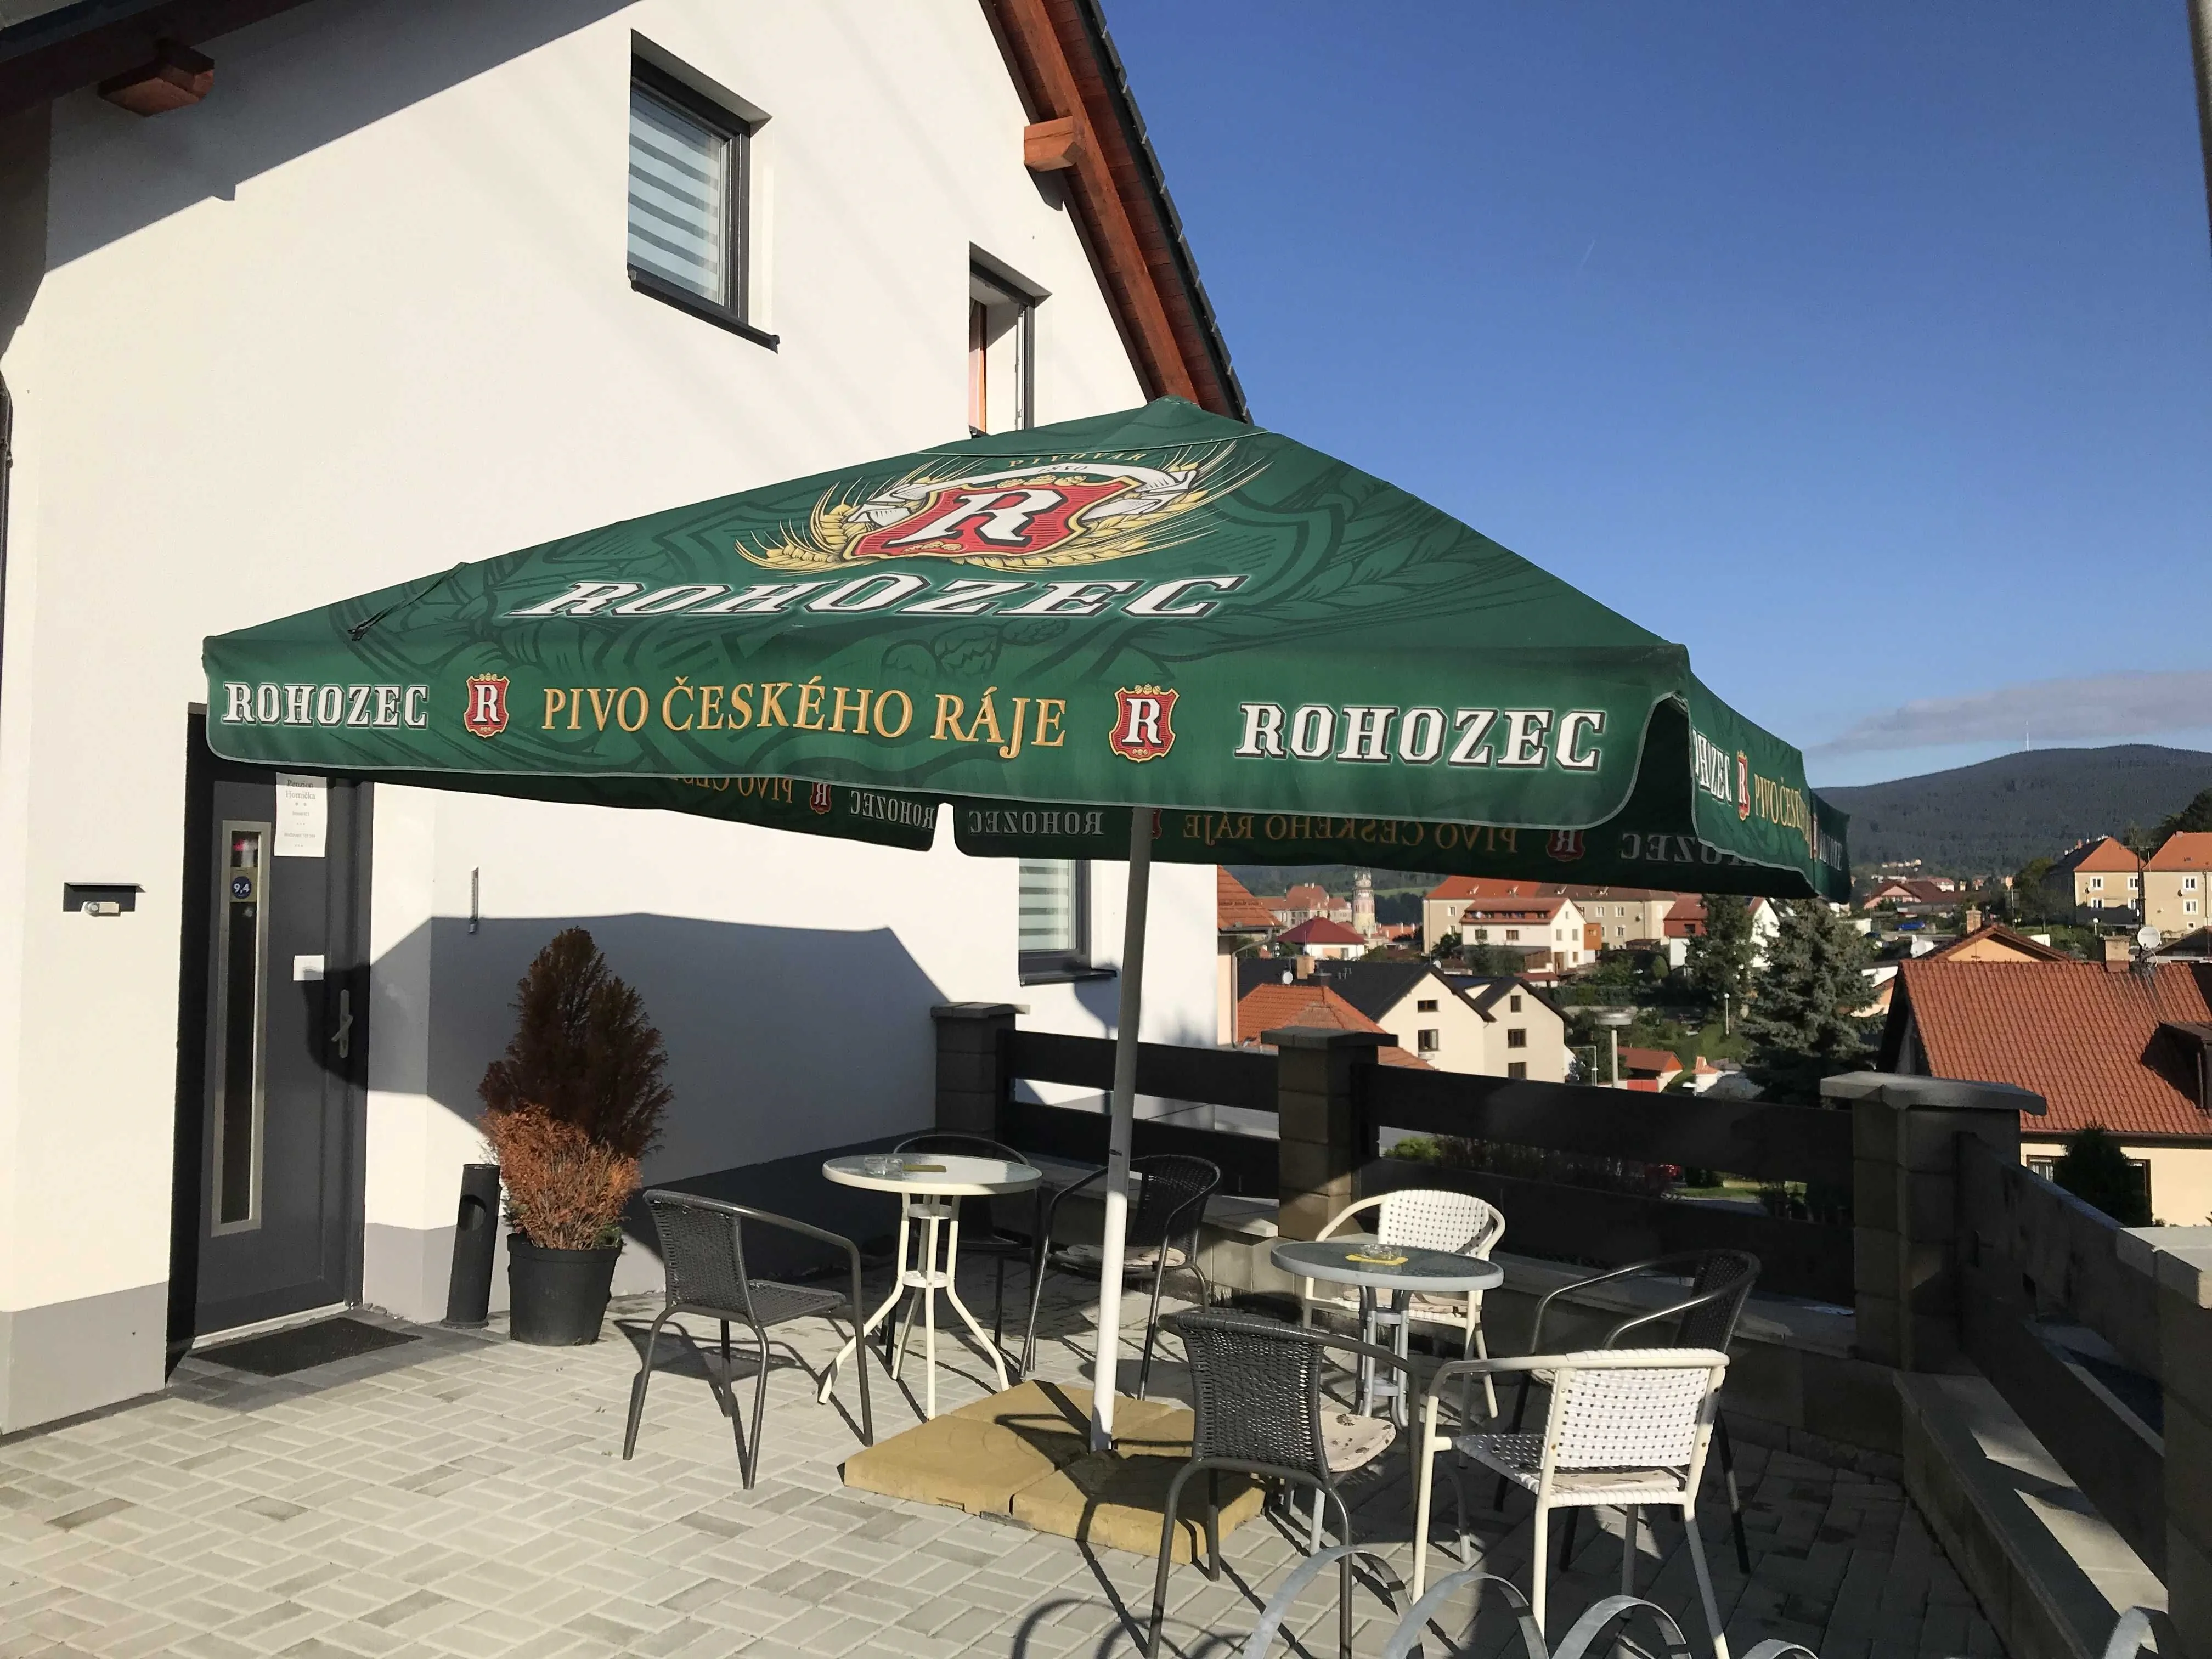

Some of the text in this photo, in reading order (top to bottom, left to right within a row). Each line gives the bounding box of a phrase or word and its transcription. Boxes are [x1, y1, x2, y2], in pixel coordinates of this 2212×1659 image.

[1009, 453, 1147, 467] PIVOVAR
[885, 488, 1061, 545] R
[505, 572, 1249, 618] ROHOZEC
[222, 675, 1606, 772] ROHOZEC R PIVO ČESKÉHO RÁJE R ROHOZEC
[1738, 761, 1747, 805] R
[1754, 772, 1779, 825] PIVO
